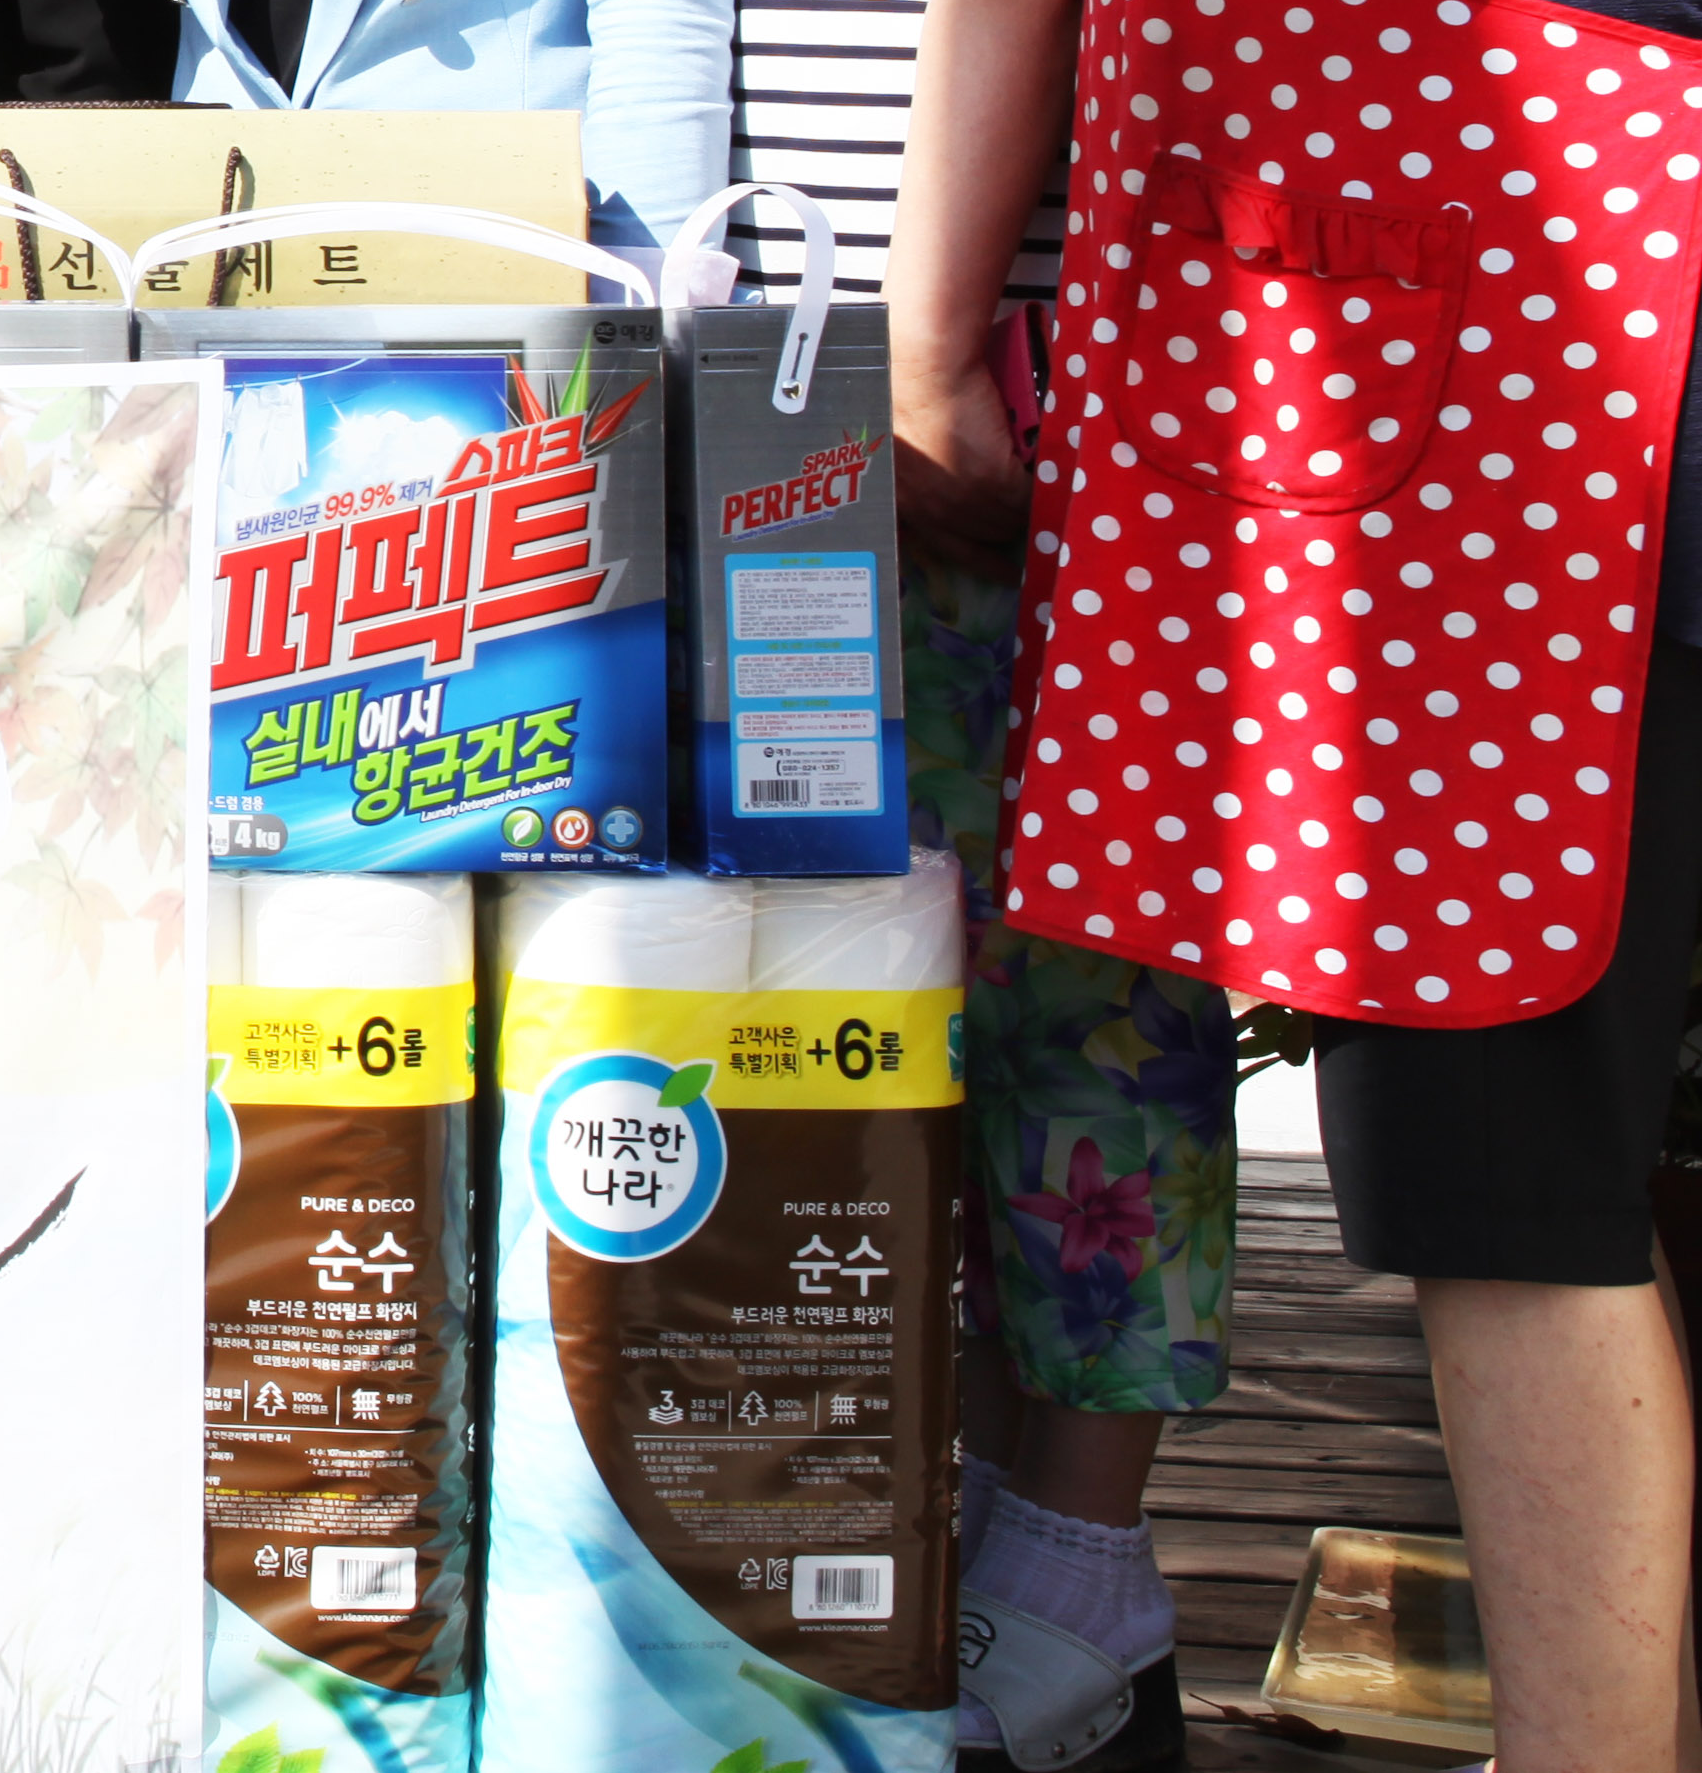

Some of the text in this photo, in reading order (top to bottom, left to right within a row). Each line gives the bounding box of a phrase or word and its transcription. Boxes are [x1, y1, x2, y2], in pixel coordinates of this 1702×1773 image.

[435, 415, 587, 499] 스파크
[801, 440, 865, 475] SPARK
[236, 478, 433, 541] 냄새원인균 99.9% 제거
[721, 459, 869, 536] PERFECT
[211, 462, 611, 692] 퍼펙트
[245, 683, 445, 786] 실내에서
[352, 704, 576, 823] 항균건조
[420, 804, 460, 823] Laundry
[554, 775, 573, 791] Dry
[255, 827, 281, 851] kg
[244, 1022, 319, 1043] 고객사은
[728, 1026, 798, 1047] 고객사은
[244, 1048, 317, 1070] 특별기획
[728, 1052, 798, 1074] 특별기획
[563, 1117, 687, 1164] 깨끗한
[300, 1196, 416, 1213] PURE & DECO
[583, 1168, 663, 1209] 나라
[783, 1202, 890, 1216] PURE & DECO
[307, 1228, 415, 1294] 순수
[789, 1233, 890, 1297] 순수
[246, 1299, 418, 1322] 부드러운 천연펄프 화장지
[731, 1306, 894, 1325] 부드러운 천연펄프 화장지
[292, 1391, 323, 1403] 100%
[773, 1398, 803, 1410] 100%
